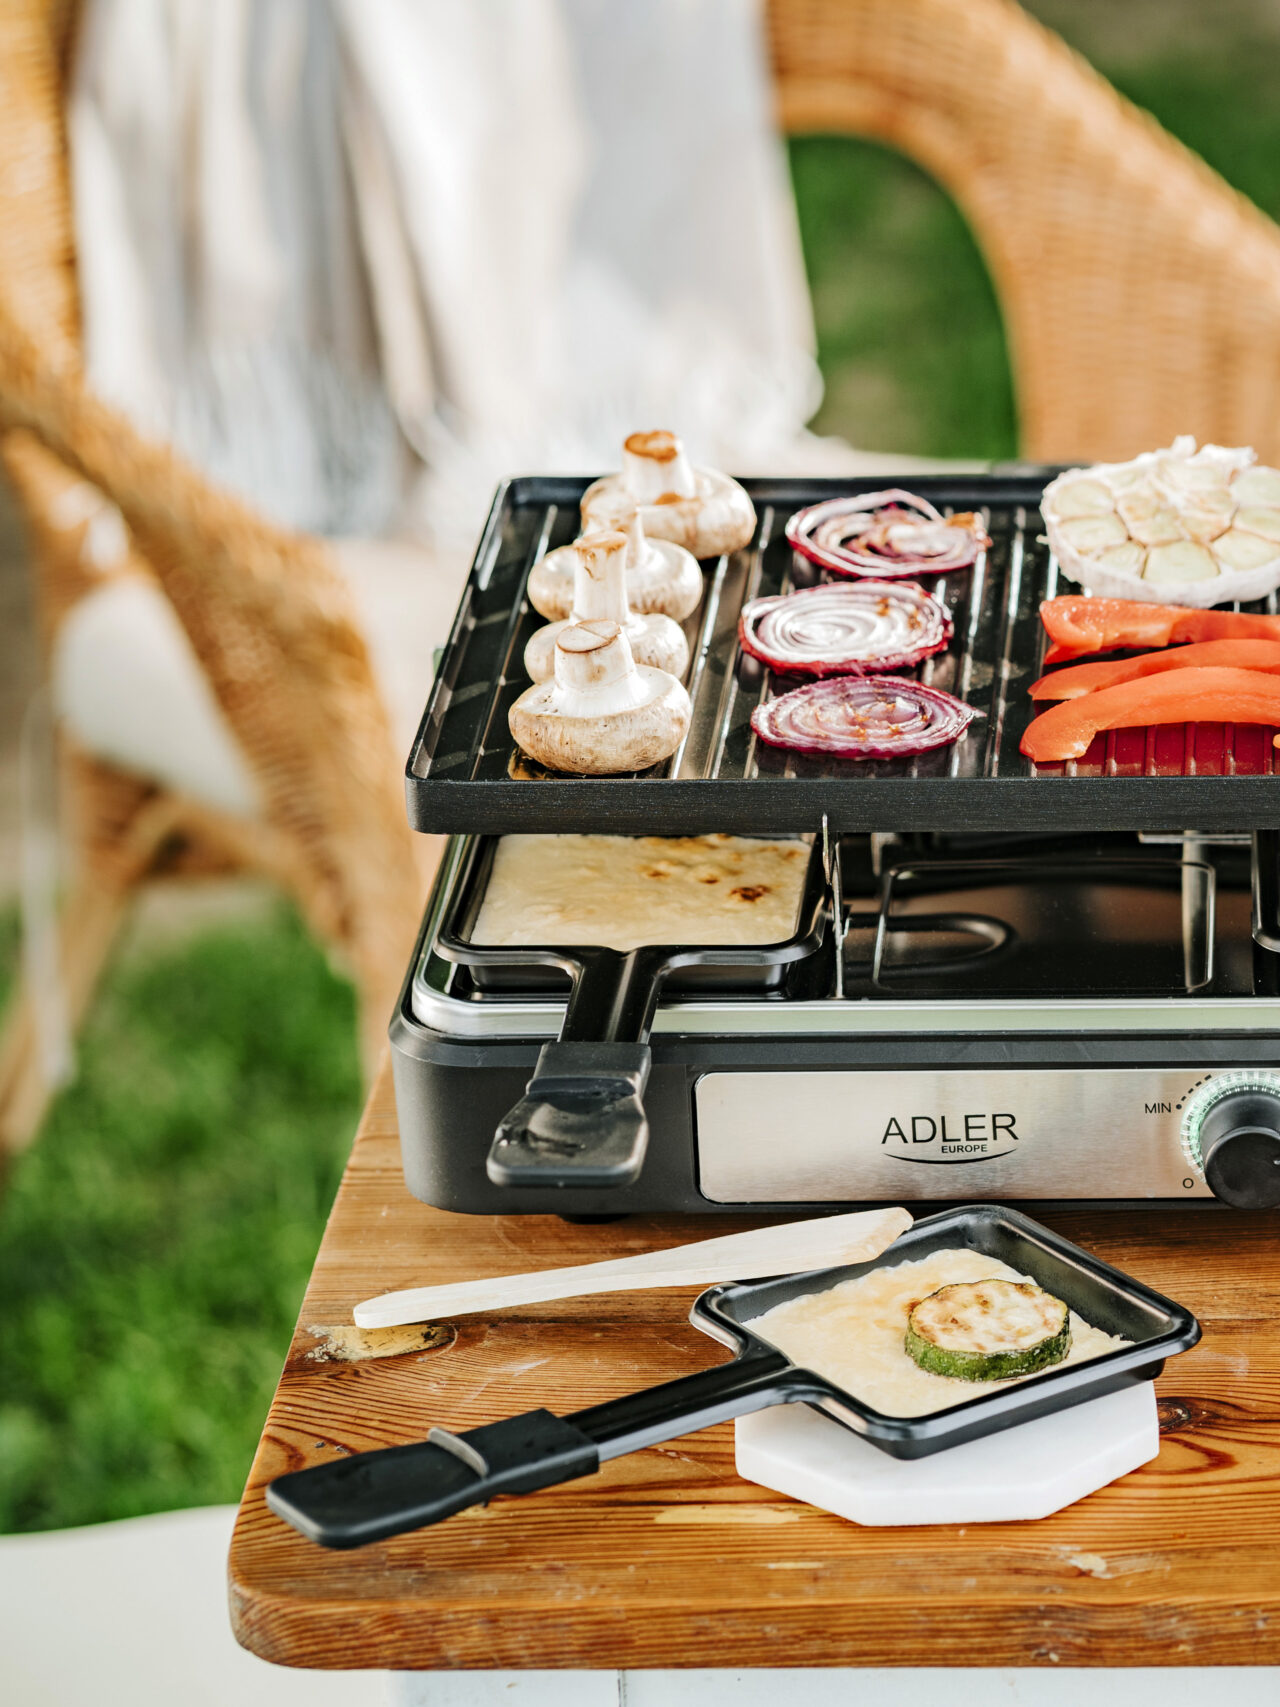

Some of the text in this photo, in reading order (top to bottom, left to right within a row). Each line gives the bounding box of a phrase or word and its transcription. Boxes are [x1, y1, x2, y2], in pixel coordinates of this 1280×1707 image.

[1144, 1102, 1172, 1114] MIN
[881, 1113, 1019, 1144] ADLER
[941, 1144, 988, 1153] EUROPE
